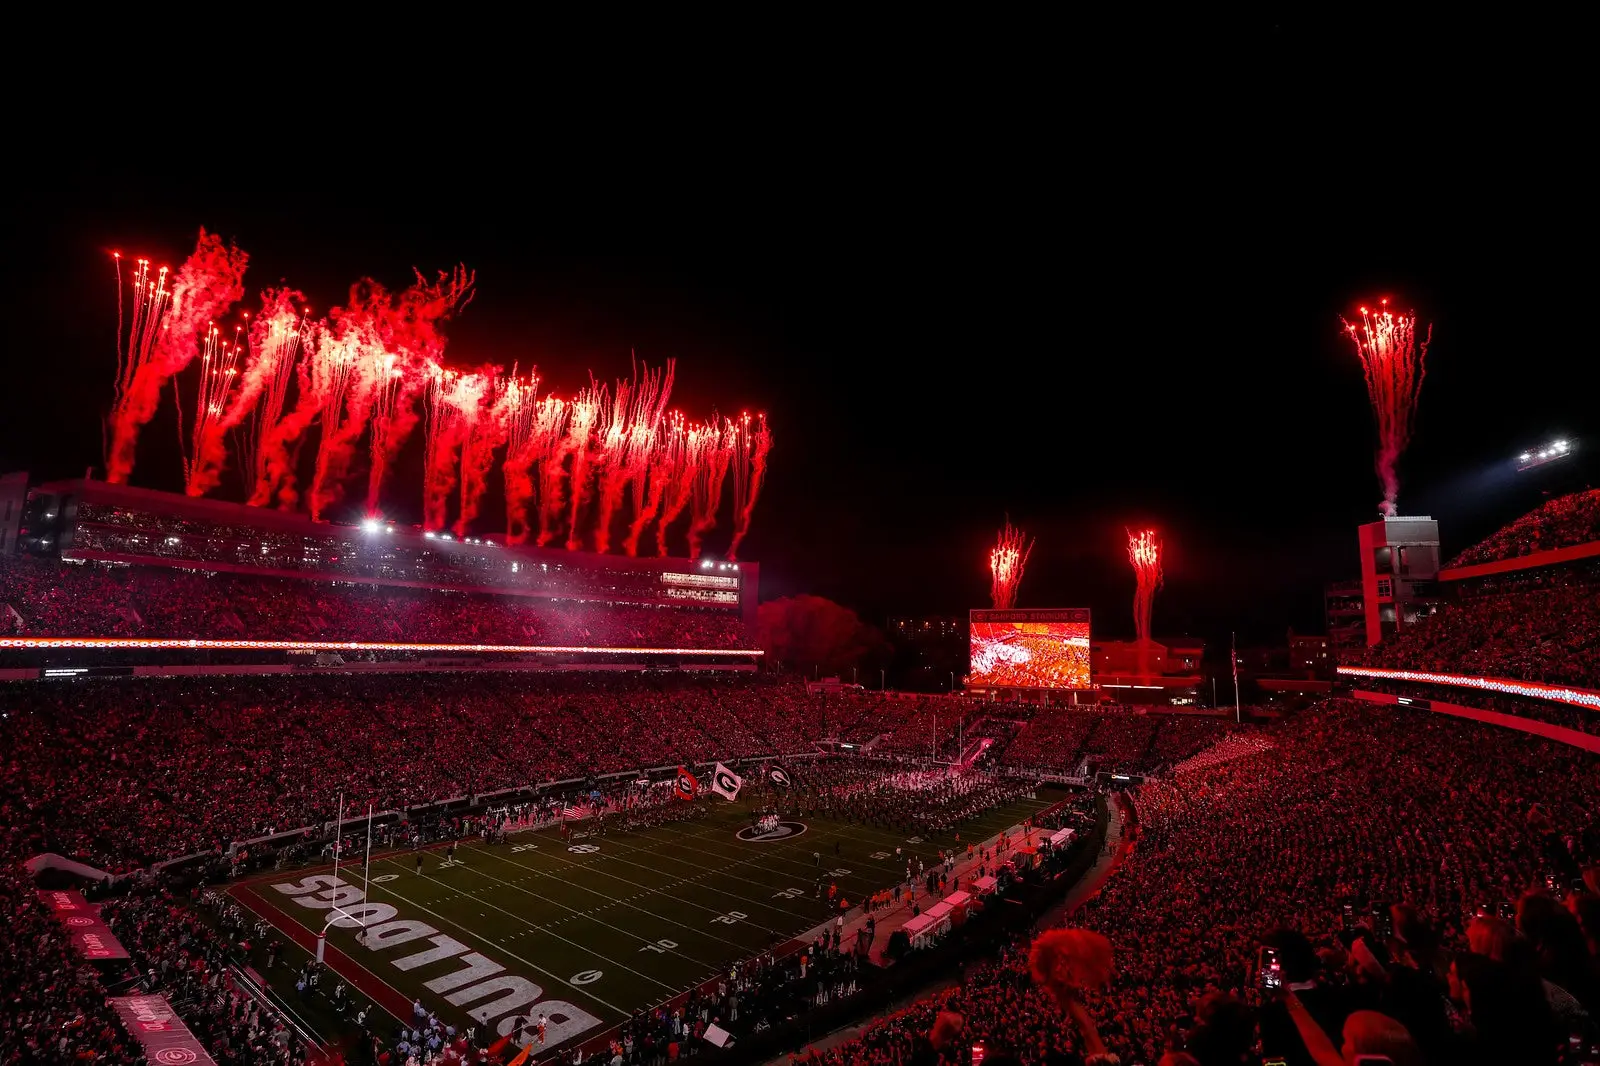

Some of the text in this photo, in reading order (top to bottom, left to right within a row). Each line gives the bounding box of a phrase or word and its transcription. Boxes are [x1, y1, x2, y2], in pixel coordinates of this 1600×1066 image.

[989, 612, 1026, 620] SANFORD
[1031, 612, 1068, 620] STADIUM
[782, 888, 805, 899] 30
[716, 911, 748, 924] 20
[648, 939, 679, 953] 10
[270, 874, 603, 1056] BULLDOGS
[570, 969, 604, 985] G
